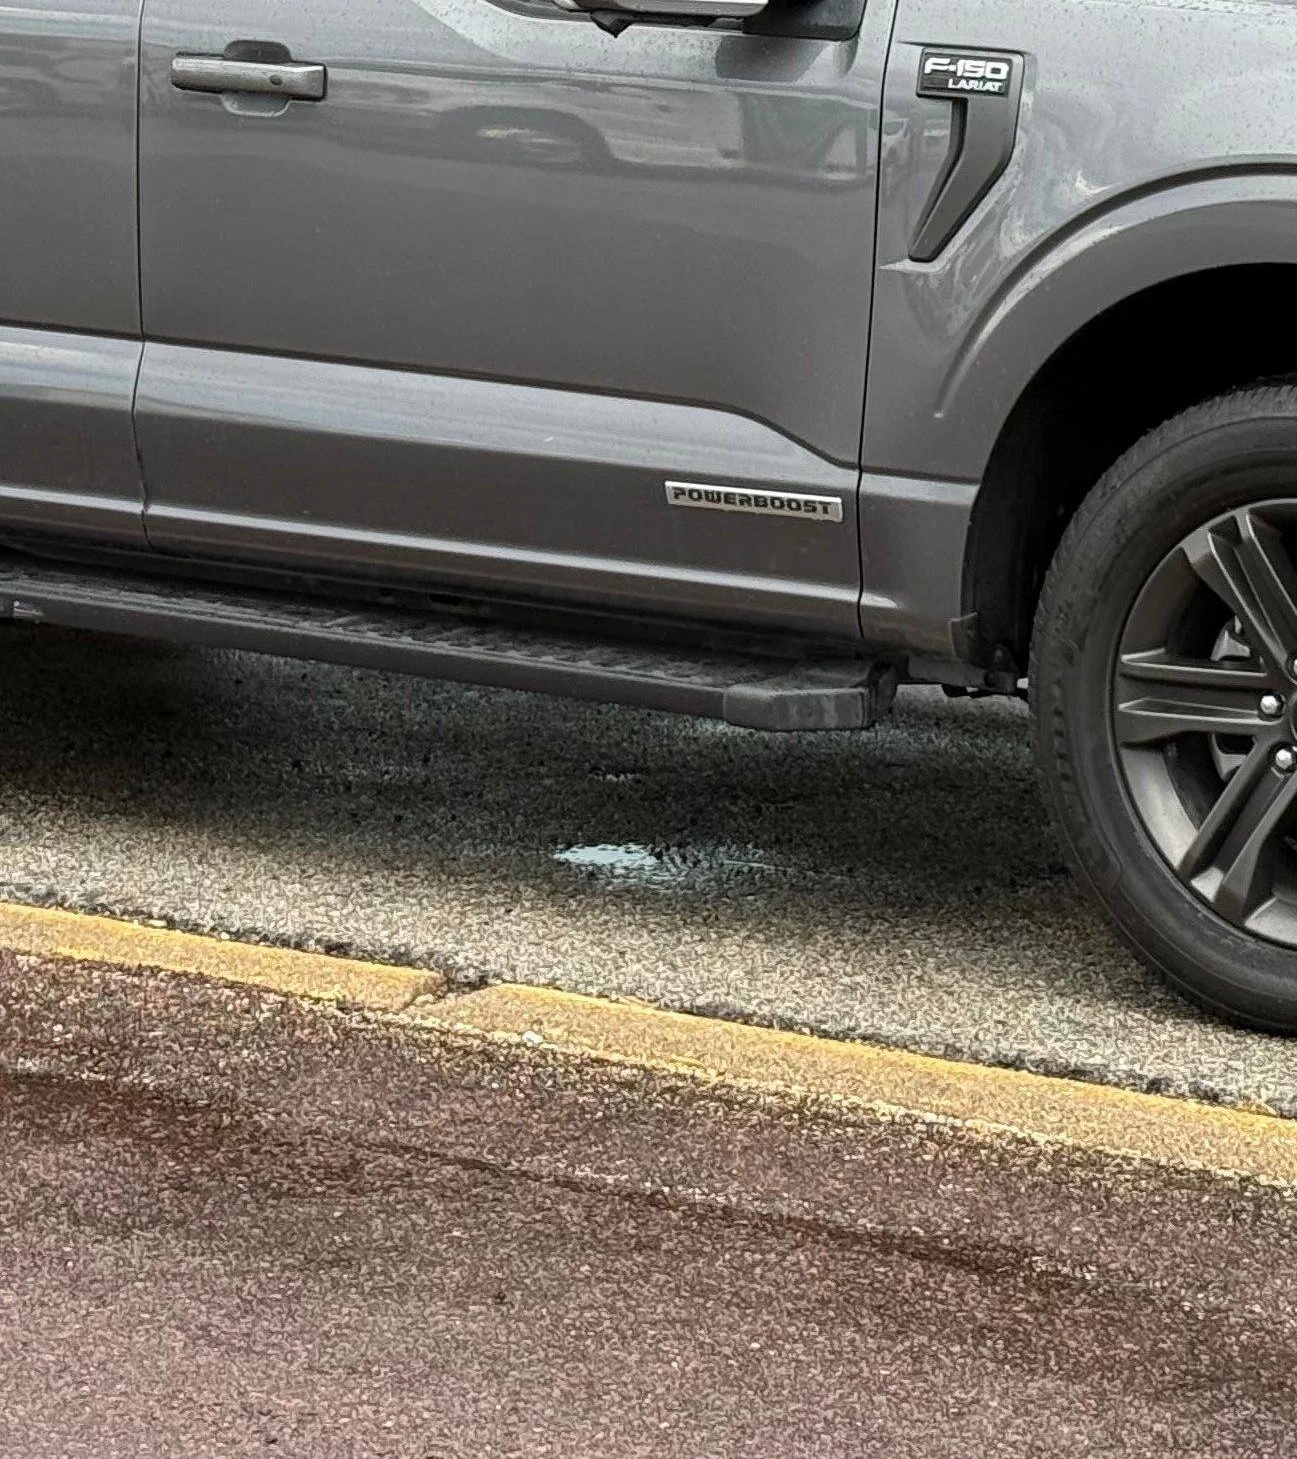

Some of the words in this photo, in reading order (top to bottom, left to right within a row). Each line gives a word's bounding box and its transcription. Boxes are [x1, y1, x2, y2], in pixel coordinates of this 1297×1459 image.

[923, 56, 1011, 79] F-150
[947, 77, 1003, 92] LARIAT
[671, 486, 832, 516] POWERBOOST
